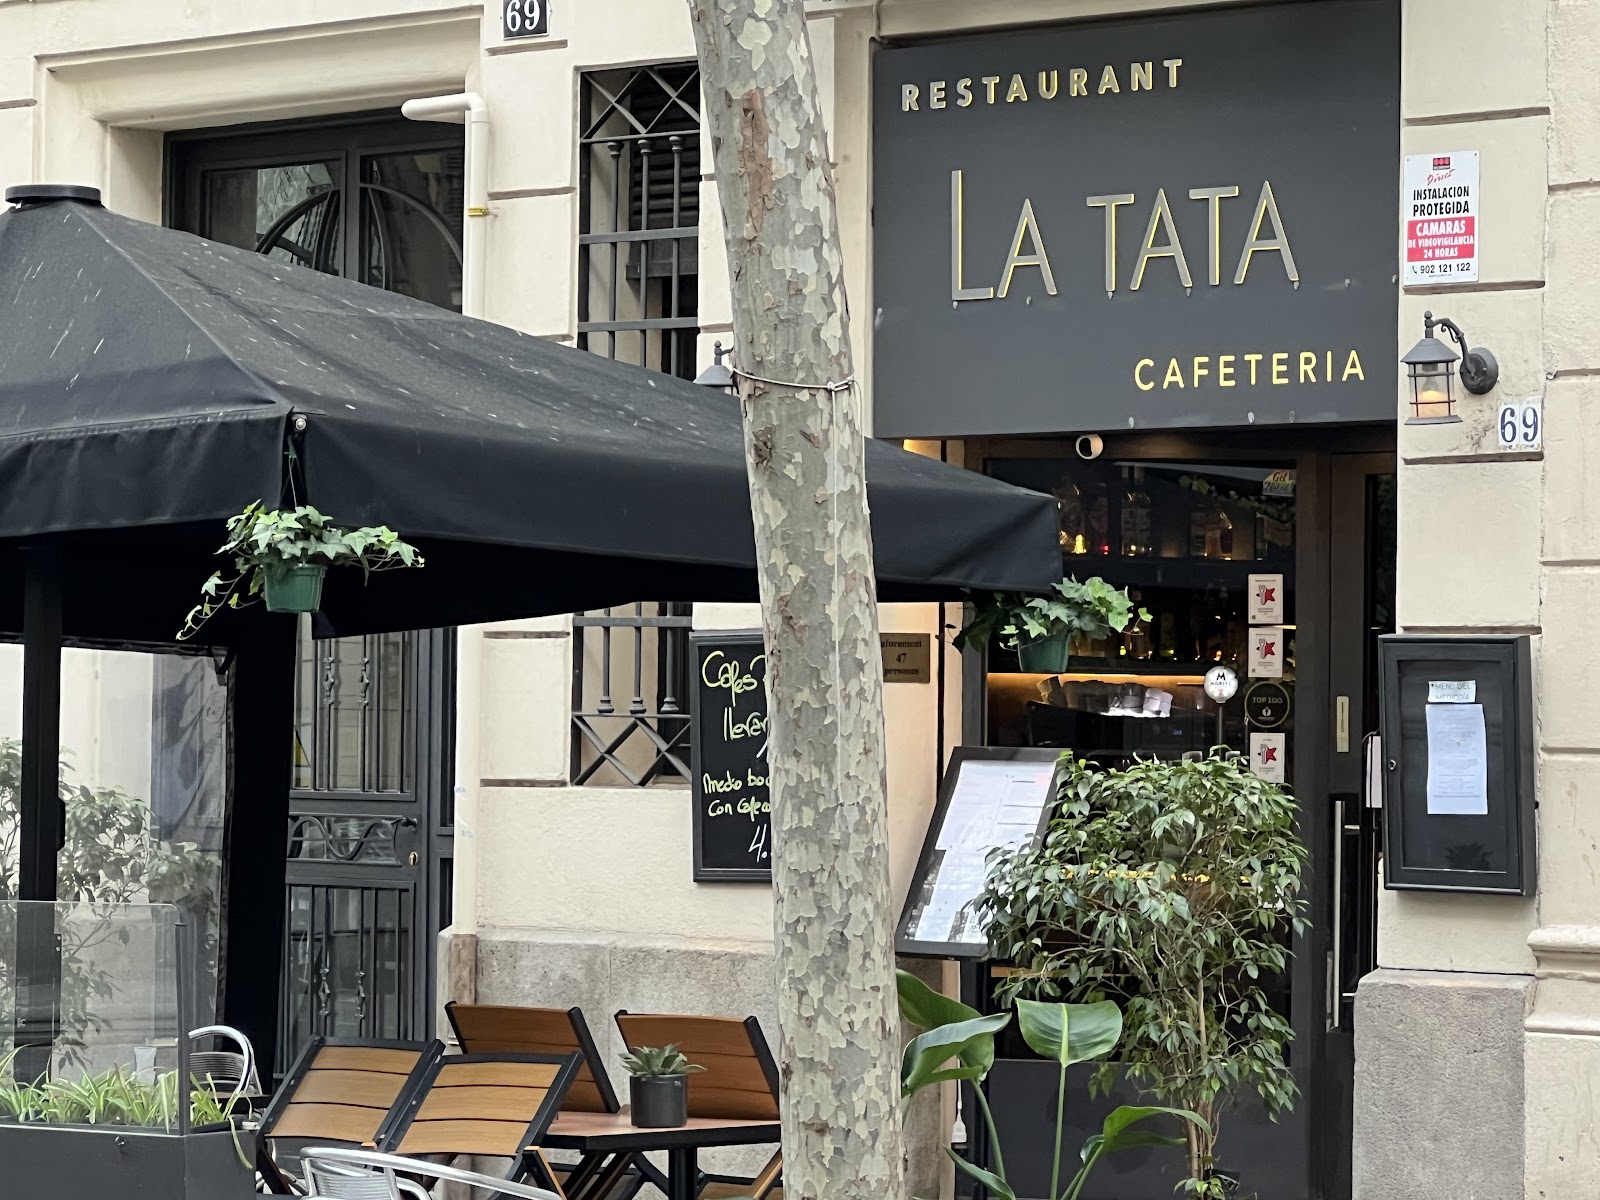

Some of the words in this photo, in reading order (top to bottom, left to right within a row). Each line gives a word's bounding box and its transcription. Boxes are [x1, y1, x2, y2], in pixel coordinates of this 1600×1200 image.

[506, 0, 541, 32] 69
[901, 58, 1183, 112] RESTAURANT
[1413, 185, 1470, 201] INSTALACION
[1413, 200, 1470, 217] PROTEGIDA
[1086, 180, 1299, 292] TATA
[1416, 219, 1466, 237] CAMARAS
[1408, 238, 1417, 249] DE
[1418, 234, 1474, 248] VIDEOVIGILANCIA
[1423, 248, 1433, 259] 24
[1434, 246, 1459, 258] HORAS
[1420, 265, 1436, 274] 902
[1438, 264, 1452, 273] 121
[1456, 262, 1471, 272] 122
[1134, 349, 1365, 391] CAFETERIA
[1500, 406, 1539, 443] 69
[895, 652, 907, 664] 47
[1456, 681, 1472, 690] DEL
[1252, 696, 1267, 704] TOP
[748, 822, 772, 864] 4.
